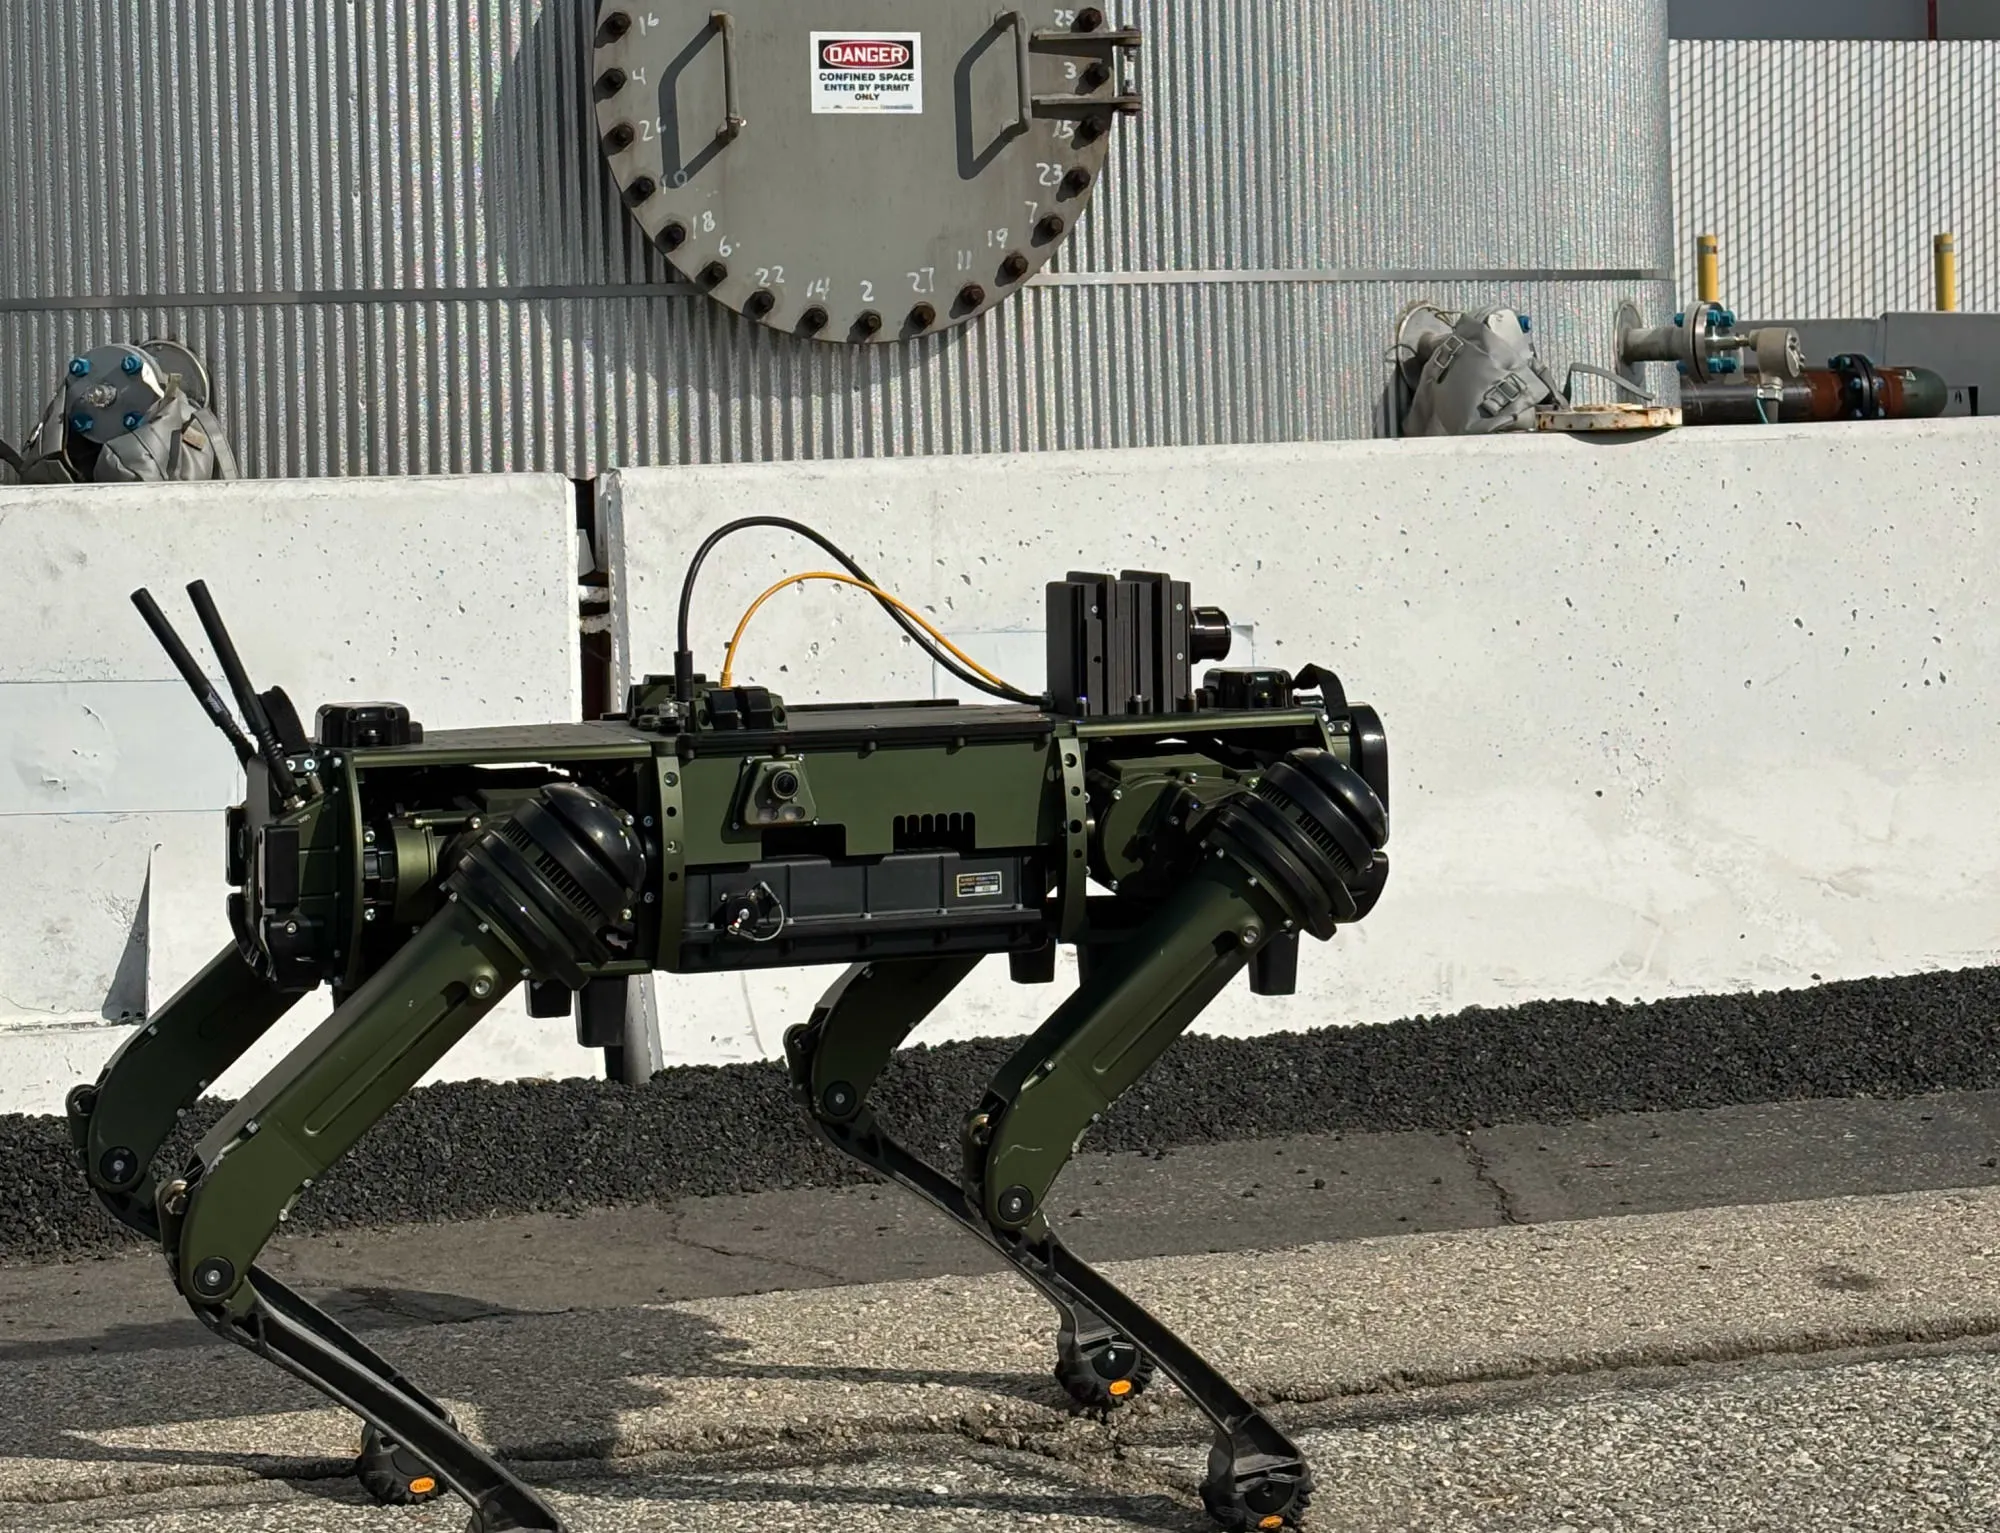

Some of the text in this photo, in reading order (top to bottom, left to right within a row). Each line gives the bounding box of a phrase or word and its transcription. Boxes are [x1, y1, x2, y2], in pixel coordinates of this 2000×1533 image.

[638, 12, 659, 37] 16
[1054, 9, 1075, 28] 25
[829, 46, 903, 62] DANGER
[632, 67, 646, 85] 4
[819, 72, 915, 82] CONFINED SPACE
[1064, 62, 1077, 79] 3
[824, 83, 910, 92] ENTER BY PERMIT
[854, 93, 880, 101] ONLY
[639, 116, 667, 141] 26
[1052, 119, 1075, 139] 15
[661, 169, 688, 194] 10
[1036, 162, 1064, 186] 23
[1024, 200, 1038, 223] 7
[692, 210, 716, 240] 18
[987, 227, 1008, 249] 19
[957, 250, 972, 270] 11
[755, 265, 785, 287] 22
[906, 267, 935, 293] 27
[806, 277, 831, 300] 14
[859, 280, 875, 302] 2
